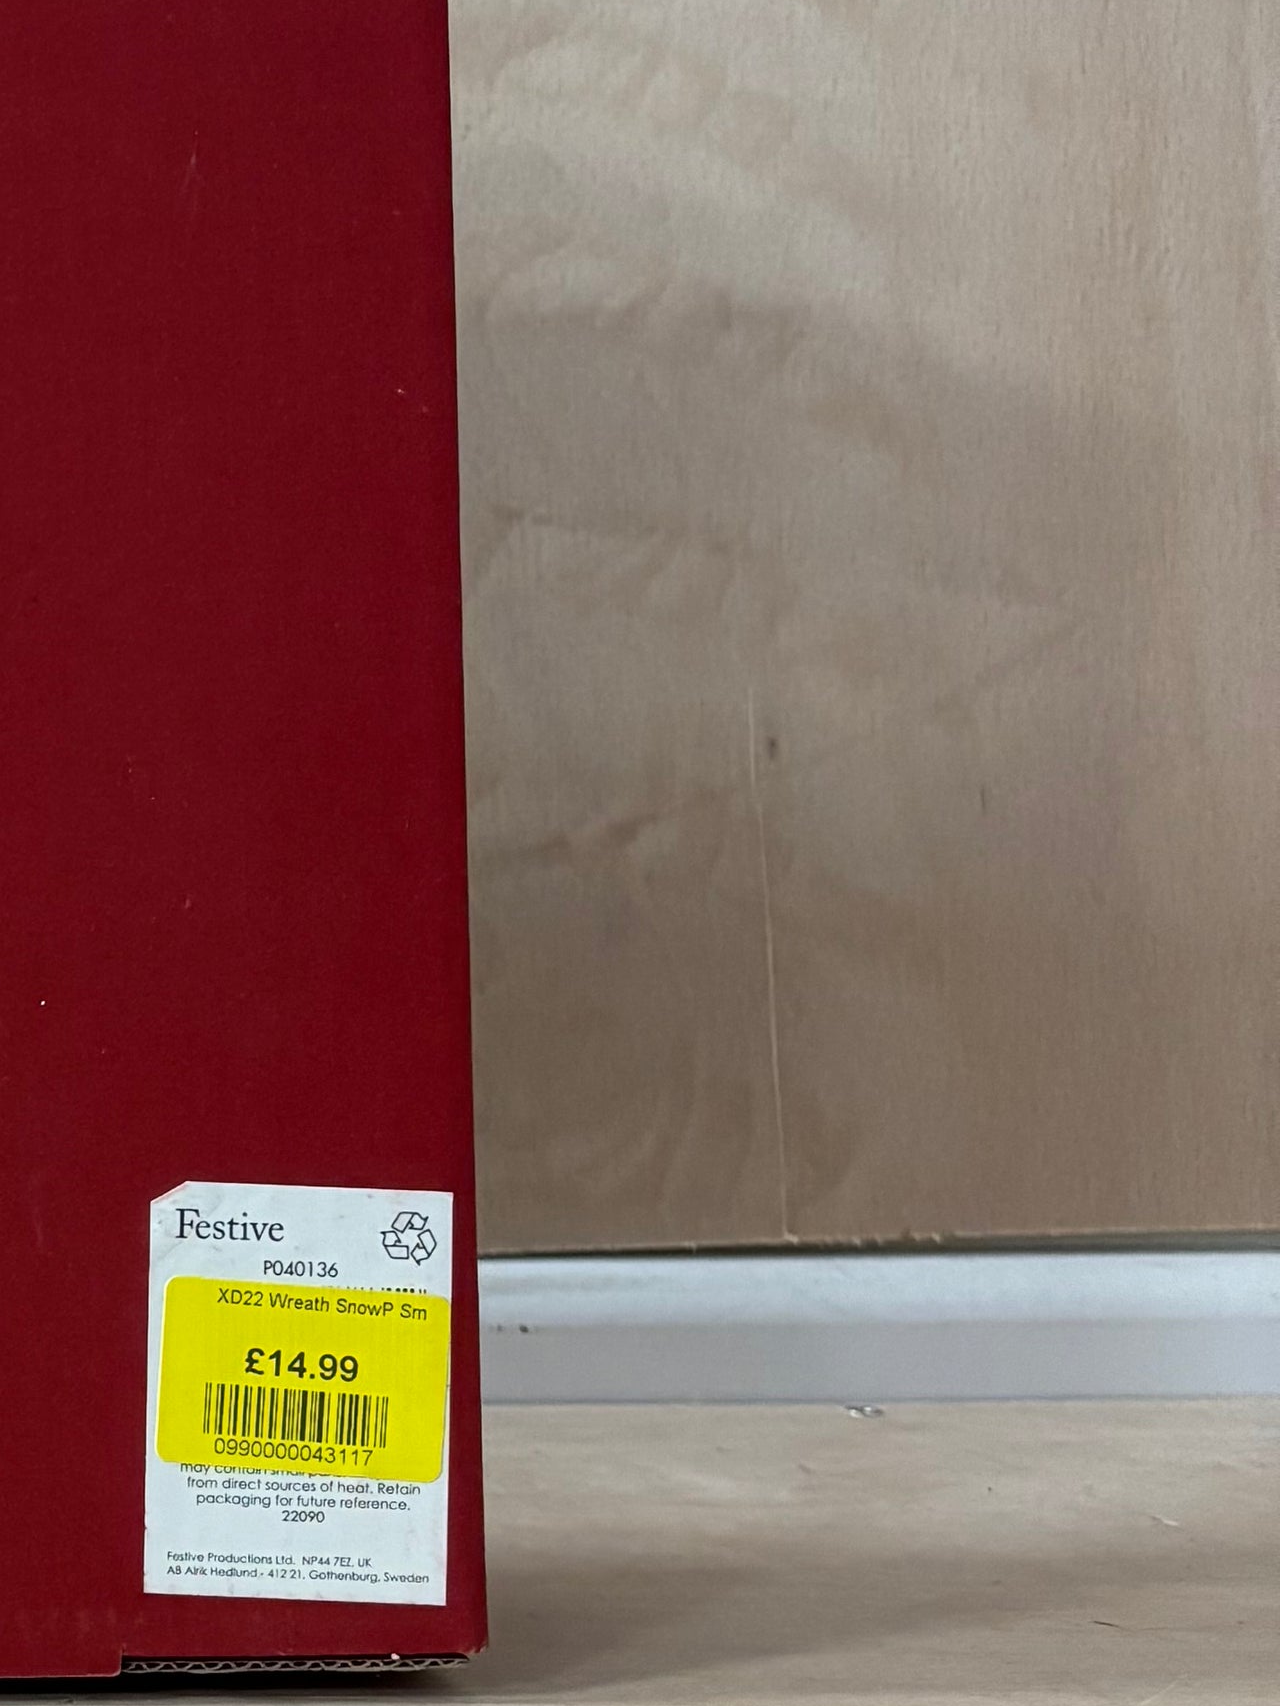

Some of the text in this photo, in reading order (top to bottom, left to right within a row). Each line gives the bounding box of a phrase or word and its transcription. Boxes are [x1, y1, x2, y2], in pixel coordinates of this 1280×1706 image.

[175, 1208, 284, 1242] Festive
[263, 1260, 338, 1278] P040136
[217, 1288, 427, 1321] XD22 Wreath SnowP Sm
[244, 1348, 359, 1382] £14.99
[214, 1437, 374, 1466] 0990000043117
[187, 1476, 421, 1495] from direct sources of heat. Retain
[196, 1493, 411, 1511] packaging for future reference.
[281, 1510, 326, 1523] 22090
[167, 1551, 204, 1563] Festive
[207, 1552, 272, 1565] Productions
[275, 1555, 295, 1566] Ltd.
[302, 1556, 331, 1566] NP44
[357, 1557, 372, 1568] UK
[210, 1567, 258, 1578] Hedlund
[268, 1568, 287, 1579] 412
[383, 1571, 429, 1583] Sweden
